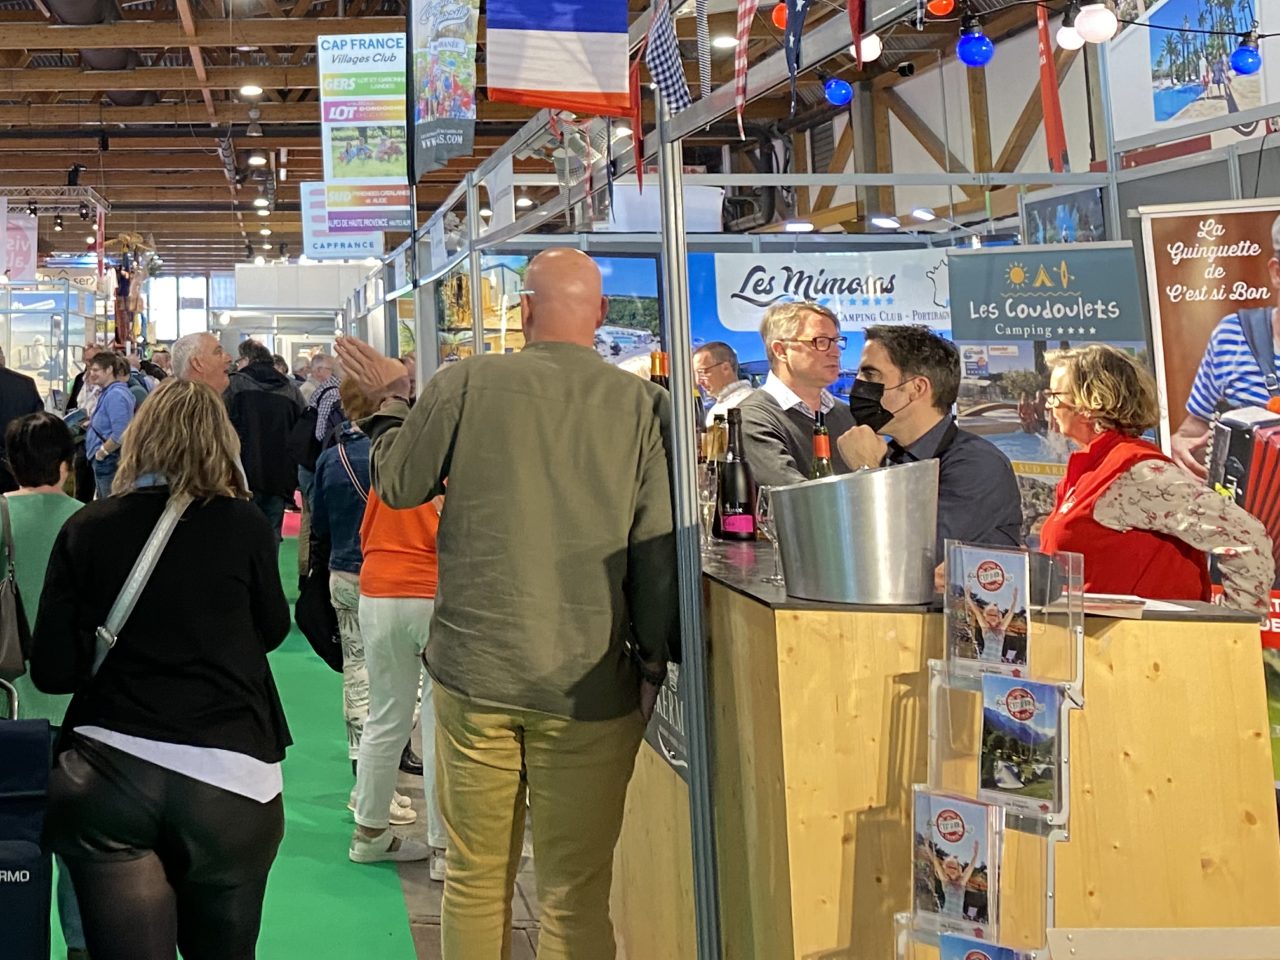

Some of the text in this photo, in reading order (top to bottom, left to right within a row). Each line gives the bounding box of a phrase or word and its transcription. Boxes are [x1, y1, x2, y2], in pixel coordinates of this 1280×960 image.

[320, 37, 405, 51] CAP FRANCE
[331, 52, 397, 65] Villages Club
[328, 105, 357, 120] LOT
[1197, 218, 1226, 241] La
[312, 240, 375, 250] CAPFRANCE
[1166, 240, 1262, 265] Guinguette
[1204, 263, 1226, 279] de
[730, 265, 777, 307] Les
[1166, 281, 1271, 302] C'est si Bon
[970, 296, 1120, 320] Les Coudoulets
[879, 311, 903, 322] CLUB
[995, 323, 1053, 338] Camping
[1019, 464, 1040, 474] SUD
